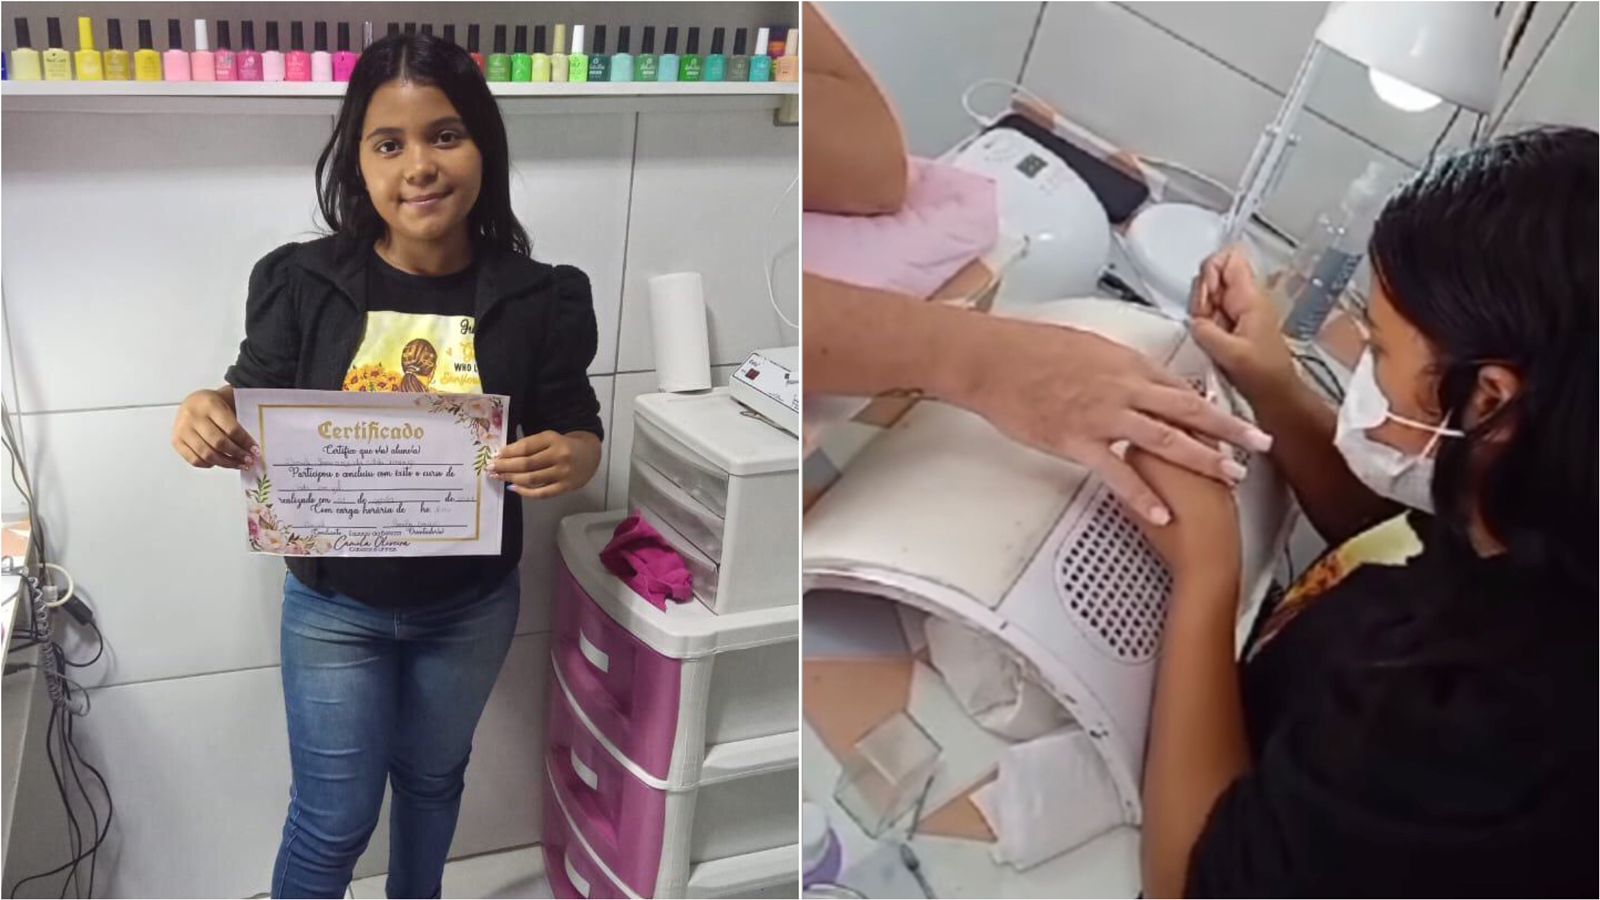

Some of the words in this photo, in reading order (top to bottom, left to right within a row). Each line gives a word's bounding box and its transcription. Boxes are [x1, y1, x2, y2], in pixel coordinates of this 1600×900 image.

[453, 362, 472, 372] WHO
[317, 420, 425, 444] Certificado
[322, 444, 356, 459] Certifico
[359, 448, 373, 459] que
[288, 466, 333, 483] Participou
[342, 466, 374, 478] concluiu
[444, 466, 456, 478] de
[278, 492, 315, 510] realizado
[317, 497, 331, 505] em
[357, 492, 367, 504] de
[444, 491, 455, 502] de
[310, 503, 333, 514] Com
[336, 507, 359, 520] carga
[396, 502, 406, 514] de
